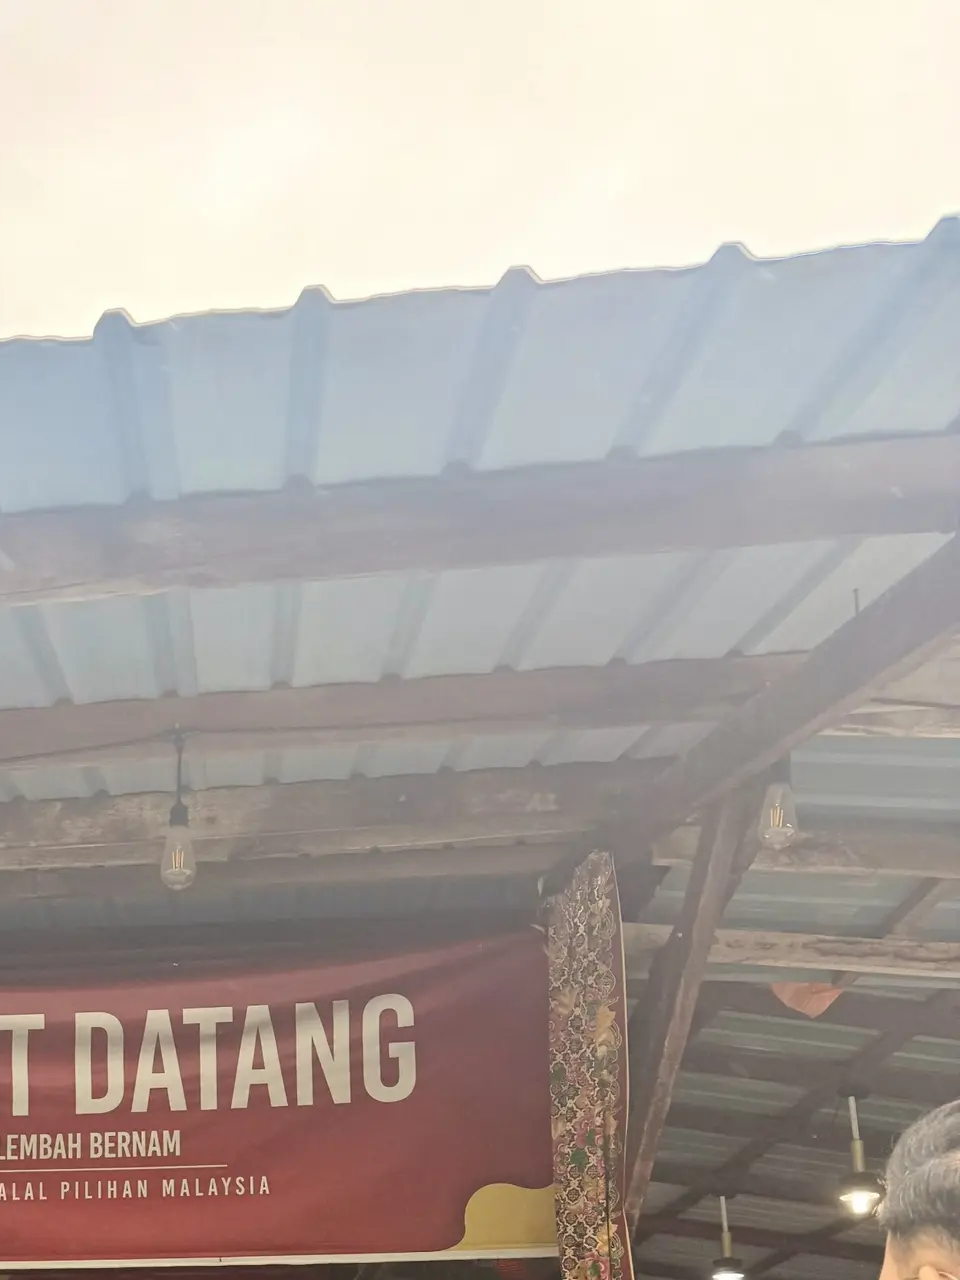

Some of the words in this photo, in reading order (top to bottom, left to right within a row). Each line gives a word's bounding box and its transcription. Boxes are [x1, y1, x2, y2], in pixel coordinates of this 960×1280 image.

[74, 993, 417, 1115] DATANG
[89, 1129, 181, 1159] BERNAM
[60, 1179, 148, 1200] PILIHAN
[162, 1176, 270, 1197] MALAYSIA
